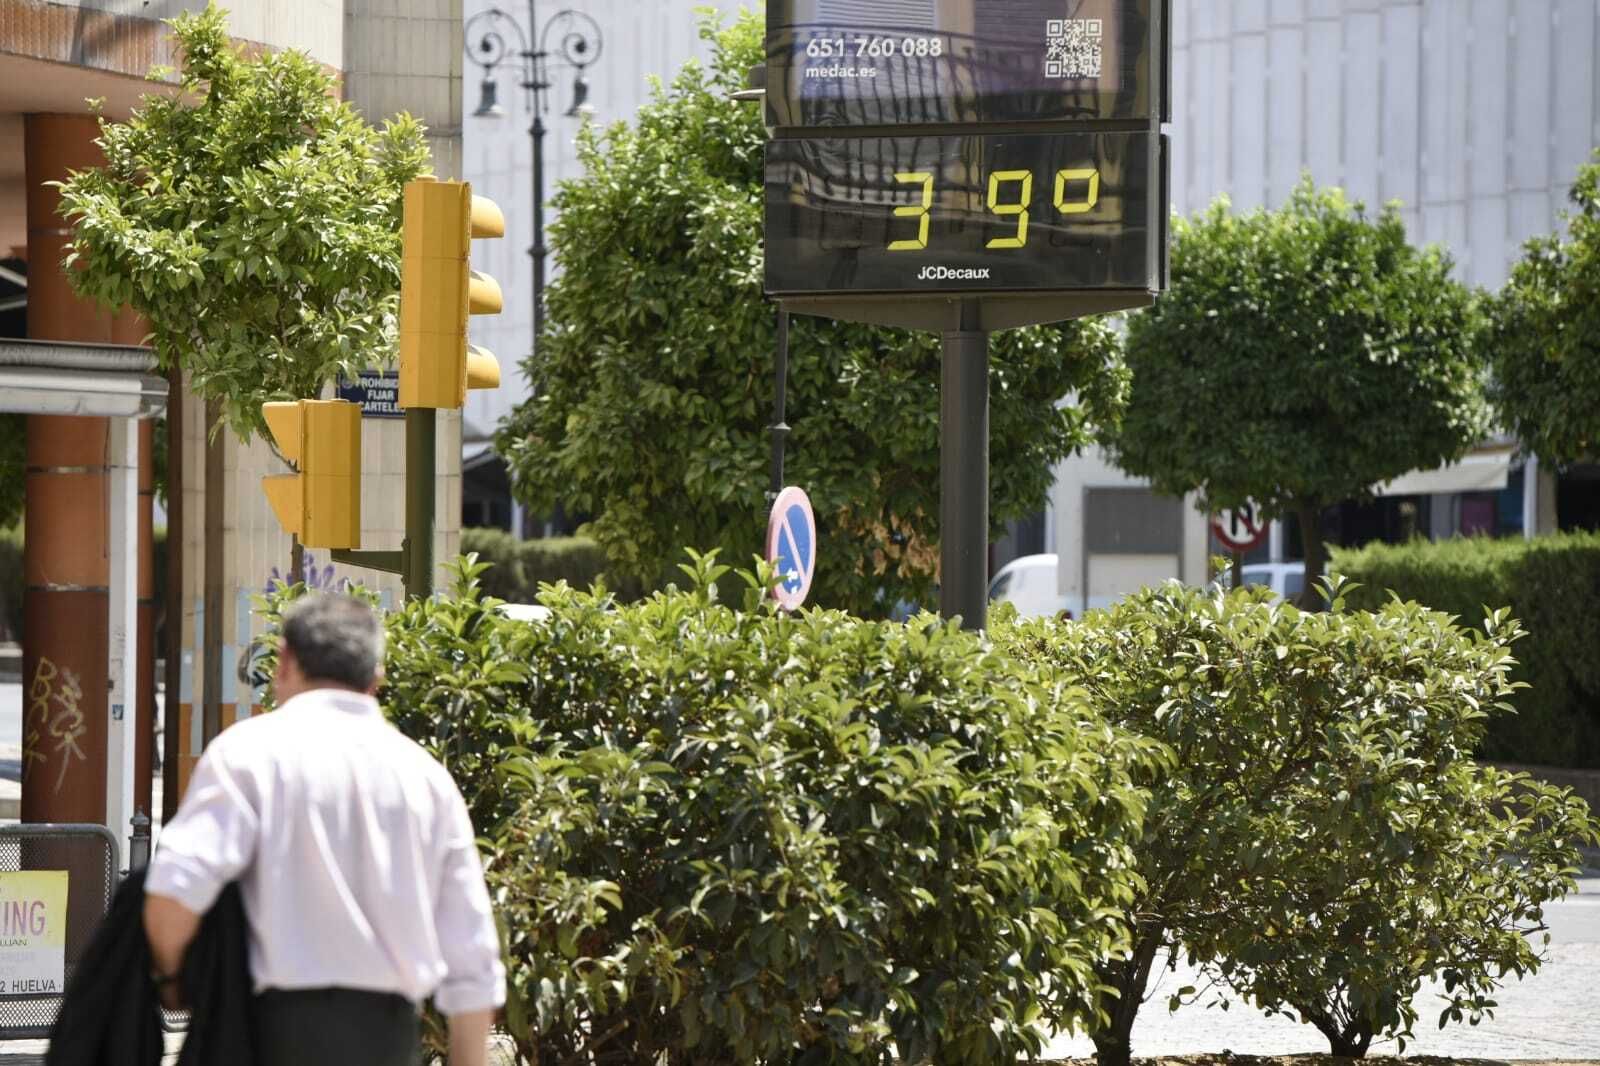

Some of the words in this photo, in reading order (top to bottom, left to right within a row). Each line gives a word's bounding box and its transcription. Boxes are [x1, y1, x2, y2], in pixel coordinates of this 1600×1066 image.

[806, 38, 845, 57] 651
[854, 38, 895, 57] 760
[902, 37, 942, 57] 088
[805, 63, 877, 78] medac.es
[917, 265, 990, 280] JCDecaux
[367, 389, 394, 401] FIJAR
[12, 979, 56, 992] HUELVA
